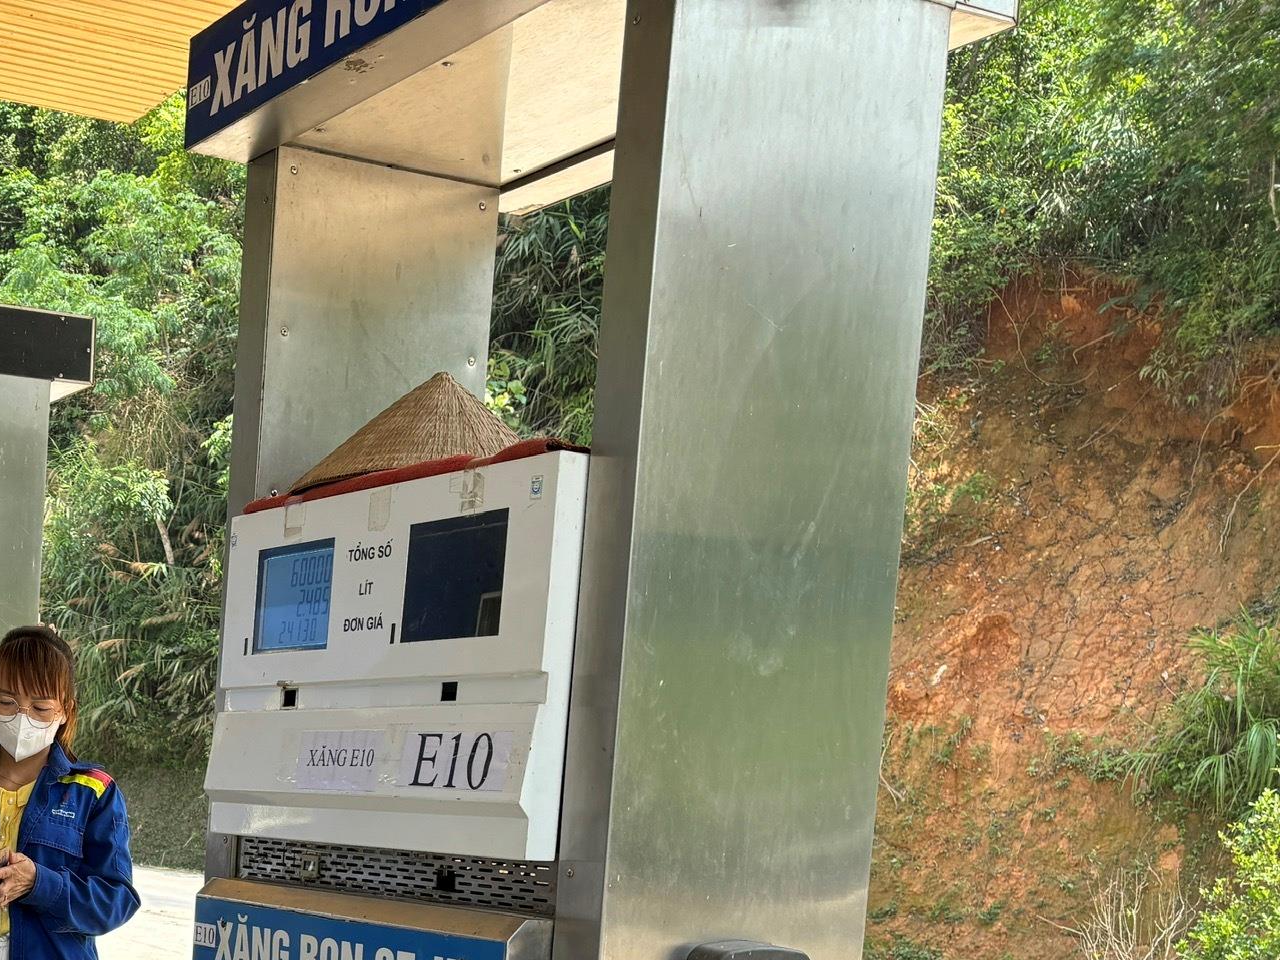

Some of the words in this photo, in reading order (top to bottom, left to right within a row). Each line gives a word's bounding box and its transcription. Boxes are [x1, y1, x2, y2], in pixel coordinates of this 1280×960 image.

[210, 0, 313, 117] XĂNG
[190, 79, 210, 106] E10
[348, 541, 375, 562] TỔNG
[377, 538, 394, 558] SỐ
[290, 553, 332, 588] 60000
[358, 579, 373, 595] LÍT
[278, 618, 318, 643] 24130
[343, 617, 364, 632] ĐƠN
[366, 612, 383, 630] GIÁ
[306, 745, 347, 766] XĂNG
[349, 749, 375, 767] E10
[408, 732, 493, 790] E10
[195, 925, 215, 945] E10
